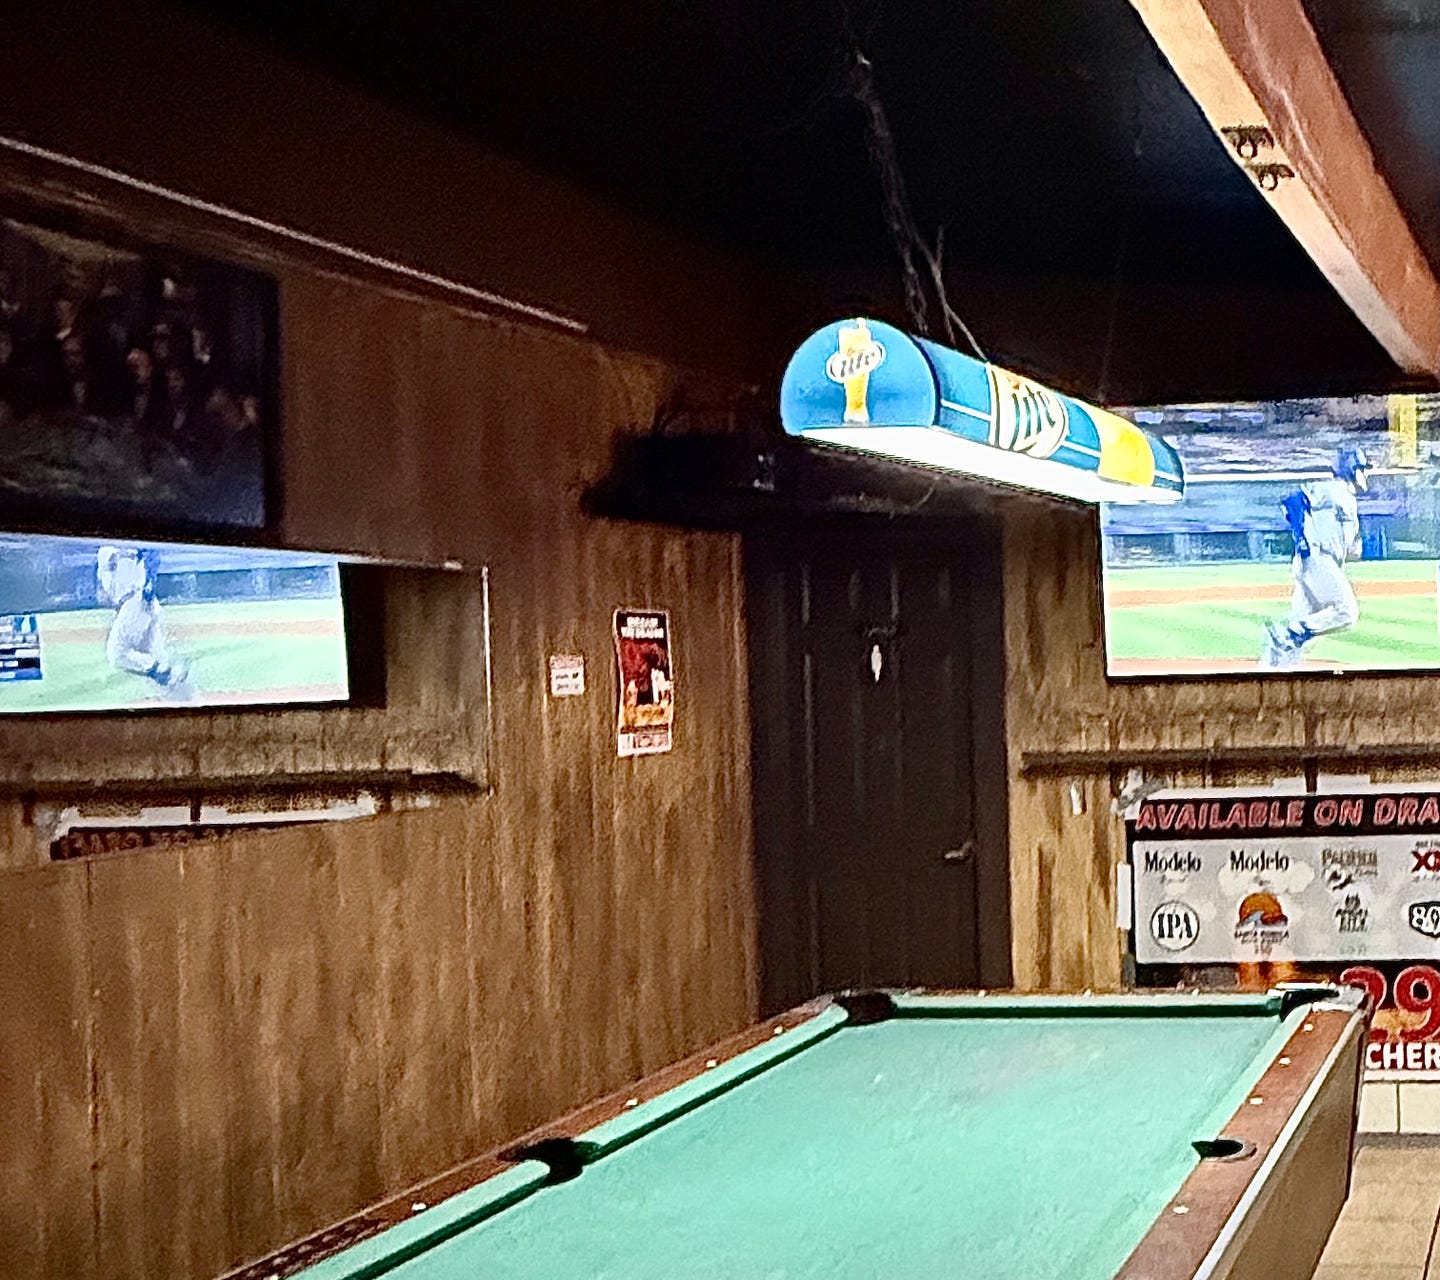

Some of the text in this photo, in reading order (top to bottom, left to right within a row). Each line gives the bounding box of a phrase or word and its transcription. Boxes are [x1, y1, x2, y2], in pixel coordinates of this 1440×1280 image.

[1135, 800, 1305, 831] AVAILABLE
[1314, 798, 1364, 827] ON
[1145, 850, 1202, 873] Modelo
[1230, 849, 1290, 872] Modelo
[1158, 911, 1194, 939] IPA
